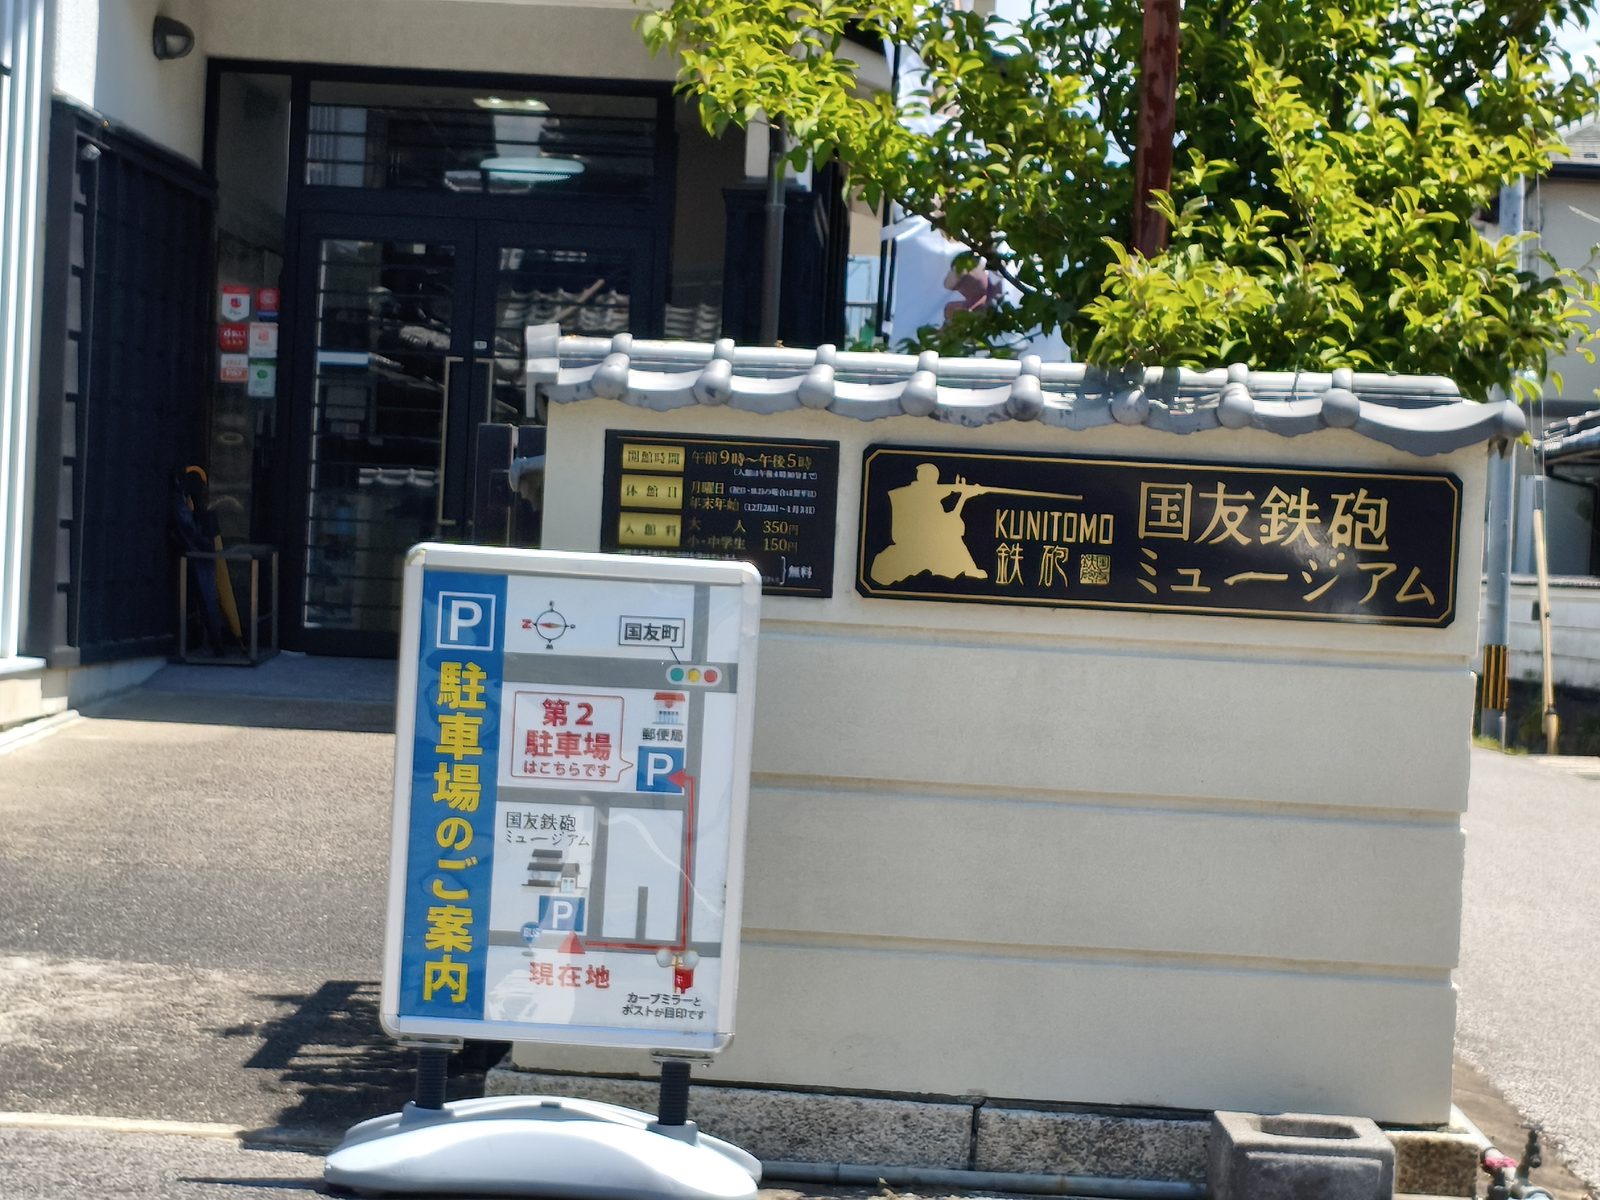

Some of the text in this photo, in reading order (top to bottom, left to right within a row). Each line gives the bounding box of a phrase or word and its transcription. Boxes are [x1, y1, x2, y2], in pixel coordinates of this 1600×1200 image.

[626, 484, 677, 498] 休館日
[691, 481, 725, 495] 月曜日
[690, 496, 740, 512] 年末年始
[995, 508, 1115, 545] KUNITOMO
[1138, 481, 1390, 551] 国友鉄砲
[625, 524, 677, 537] 入館料
[762, 519, 798, 536] 350円
[763, 537, 798, 553] 150円
[1136, 547, 1436, 606] ミュージアム
[450, 600, 483, 641] P
[624, 623, 680, 642] 国友町
[542, 698, 594, 727] 第2
[525, 730, 612, 761] 駐車場
[642, 727, 684, 743] 郵便局
[523, 760, 611, 777] はこちらです
[647, 752, 674, 786] P
[505, 811, 577, 832] 国友鉄砲
[423, 662, 487, 1003] 駐車場のご案内
[505, 830, 590, 847] ミュージアム
[552, 900, 573, 929] P
[529, 962, 611, 989] 現在地
